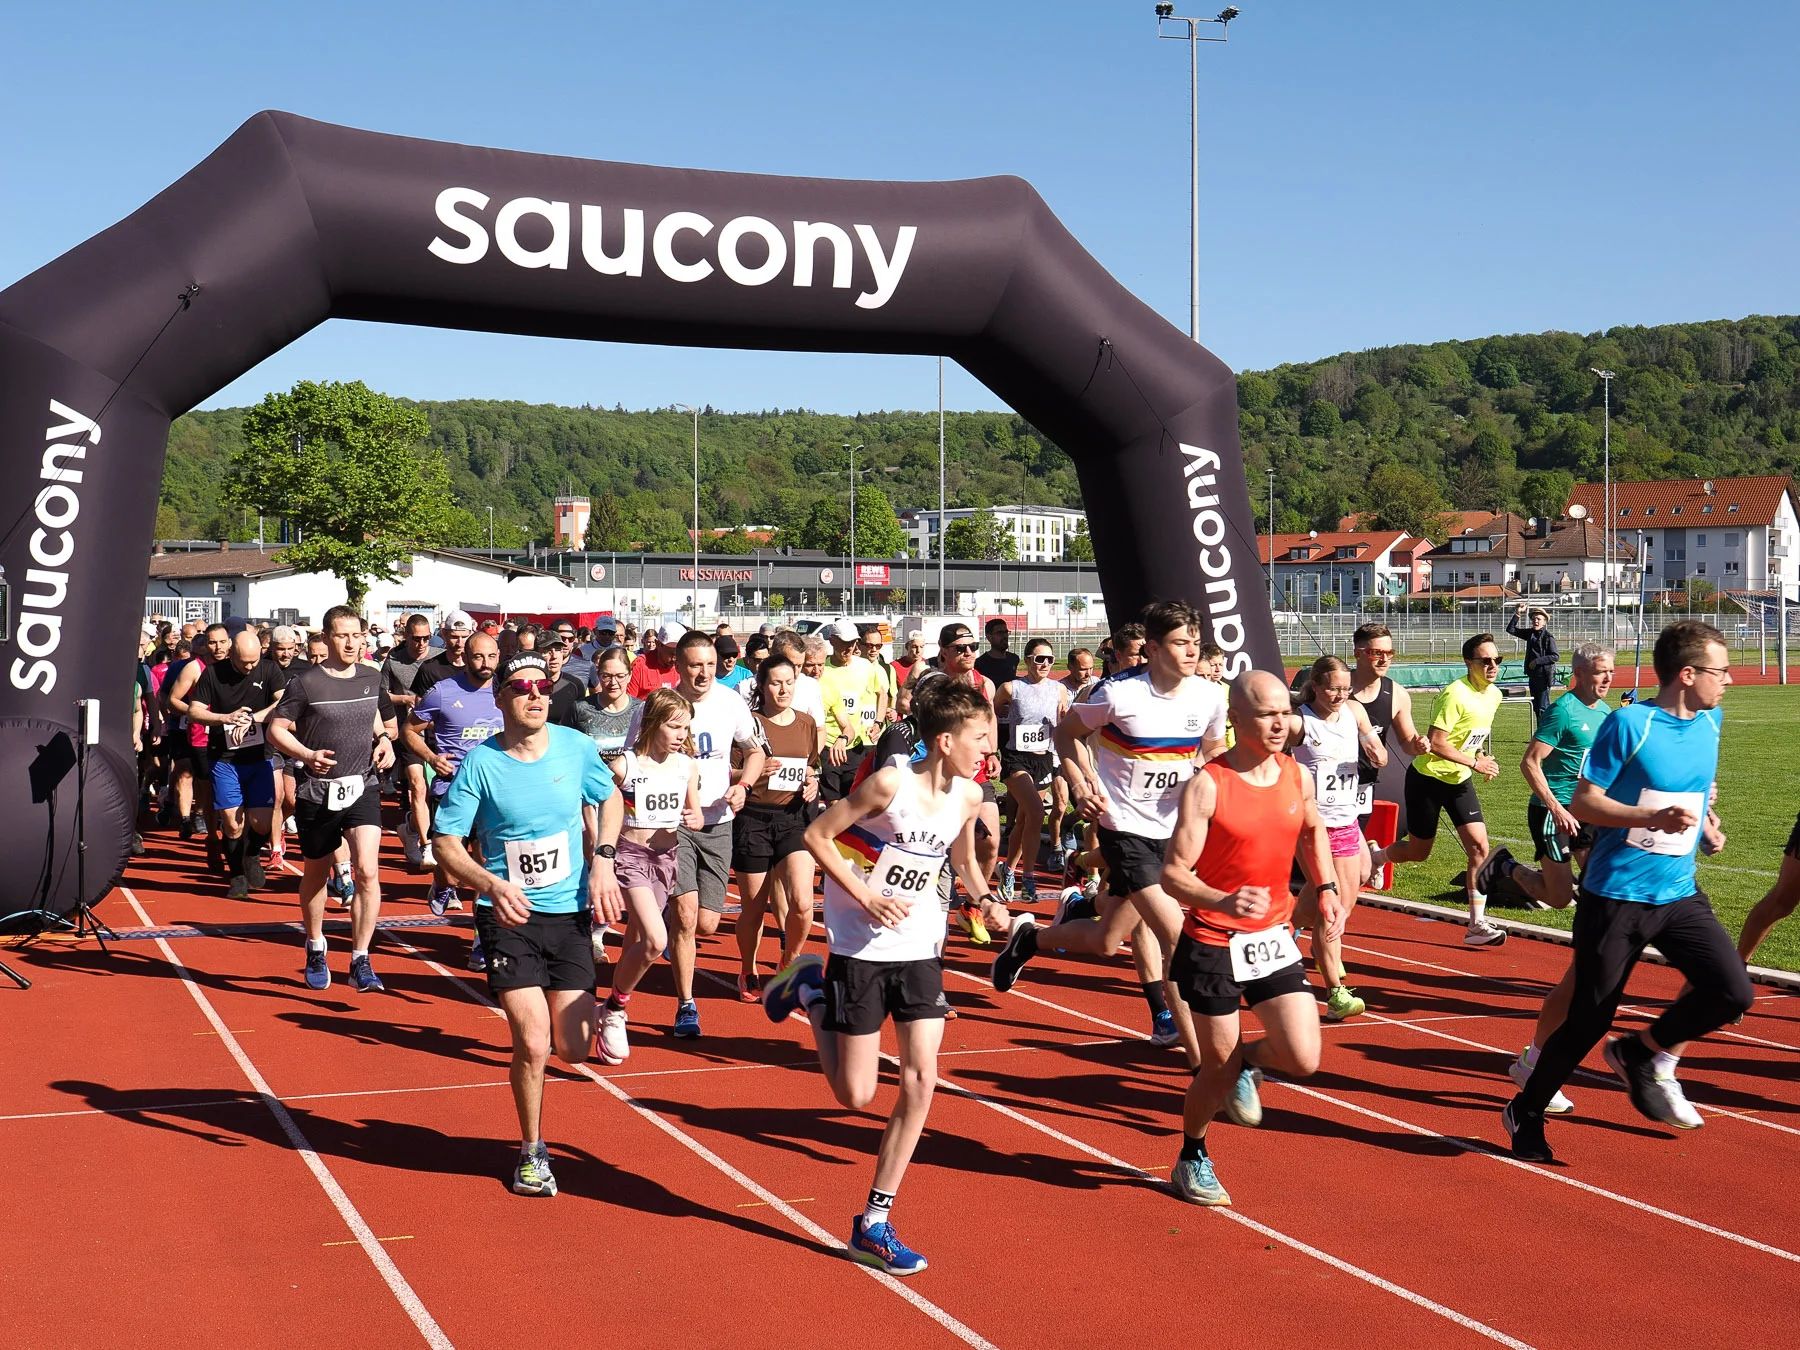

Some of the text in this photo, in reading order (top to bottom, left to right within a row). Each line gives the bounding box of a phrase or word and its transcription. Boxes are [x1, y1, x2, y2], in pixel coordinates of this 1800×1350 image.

[427, 187, 918, 310] saucony
[9, 398, 102, 696] saucony
[1178, 442, 1253, 681] saucony
[679, 568, 753, 582] ROSSMANN
[1022, 731, 1045, 743] 688
[778, 767, 804, 782] 498
[1144, 771, 1179, 789] 780
[1325, 773, 1355, 791] 217
[645, 792, 680, 812] 685
[894, 830, 946, 851] HANAU
[518, 848, 559, 875] 857
[885, 864, 931, 892] 686
[1243, 939, 1286, 965] 692
